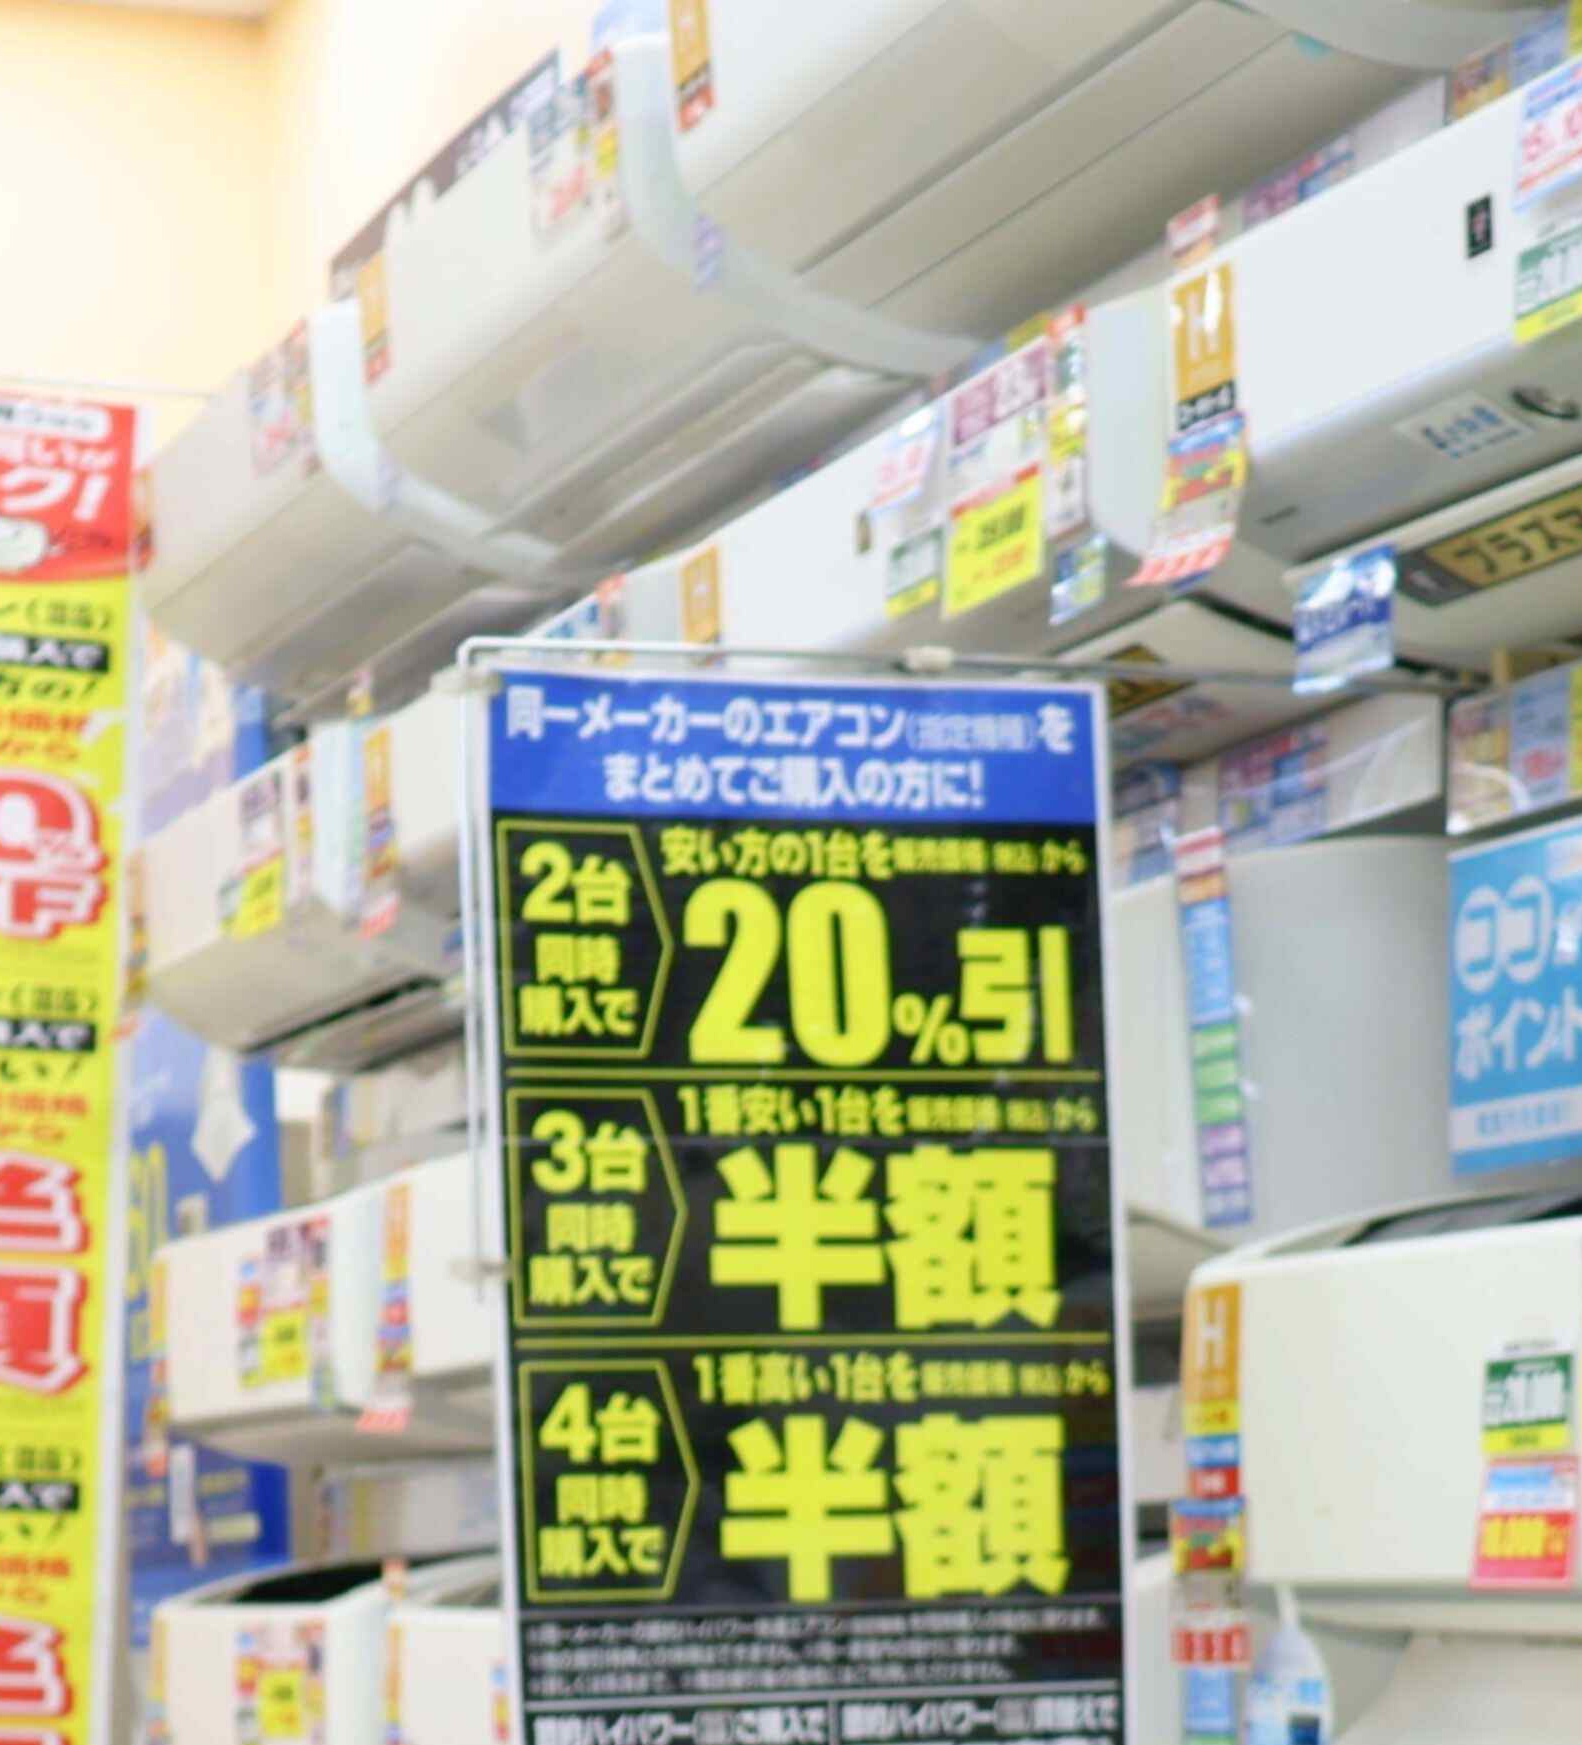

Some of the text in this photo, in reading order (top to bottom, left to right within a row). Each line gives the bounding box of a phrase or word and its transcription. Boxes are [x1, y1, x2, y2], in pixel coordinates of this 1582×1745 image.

[604, 755, 985, 808] まとめてご購入の方に!
[521, 841, 631, 927] 2台
[535, 934, 619, 984] 同時
[521, 988, 638, 1037] 購入で
[531, 1109, 647, 1194] 3台
[547, 1204, 635, 1253] 同時
[710, 1144, 1061, 1330] 半額
[530, 1257, 652, 1306] 購入で
[540, 1383, 658, 1463] 4台
[556, 1474, 646, 1523] 同時
[721, 1414, 1071, 1602] 半額
[540, 1527, 664, 1578] 購入で
